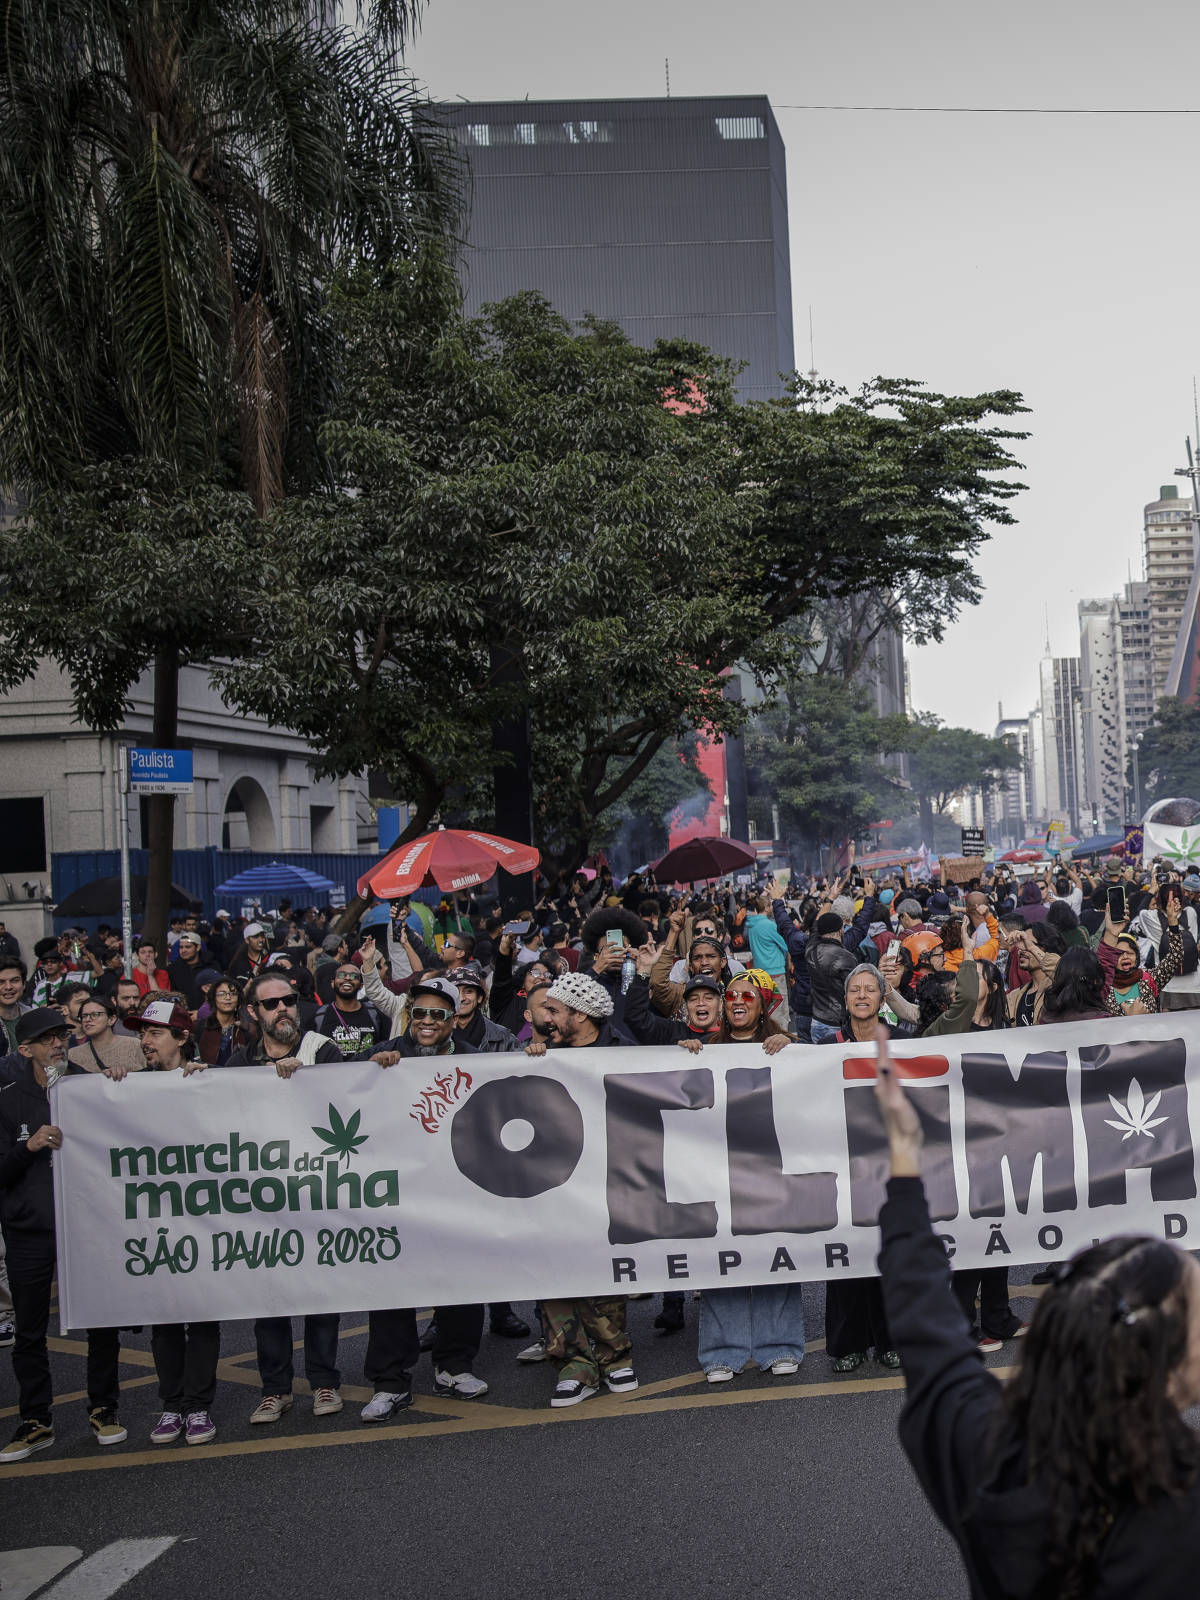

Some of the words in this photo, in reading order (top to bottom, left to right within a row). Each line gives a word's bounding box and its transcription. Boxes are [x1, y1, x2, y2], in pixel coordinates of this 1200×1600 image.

[130, 750, 175, 768] Paulista
[396, 841, 430, 876] BRAHMA
[451, 873, 481, 888] BRAHMA
[109, 1132, 290, 1177] marcha
[294, 1152, 324, 1173] da
[125, 1160, 400, 1220] maconha
[124, 1227, 198, 1276] SÃO
[211, 1228, 304, 1272] PAULO
[317, 1225, 401, 1267] 2025
